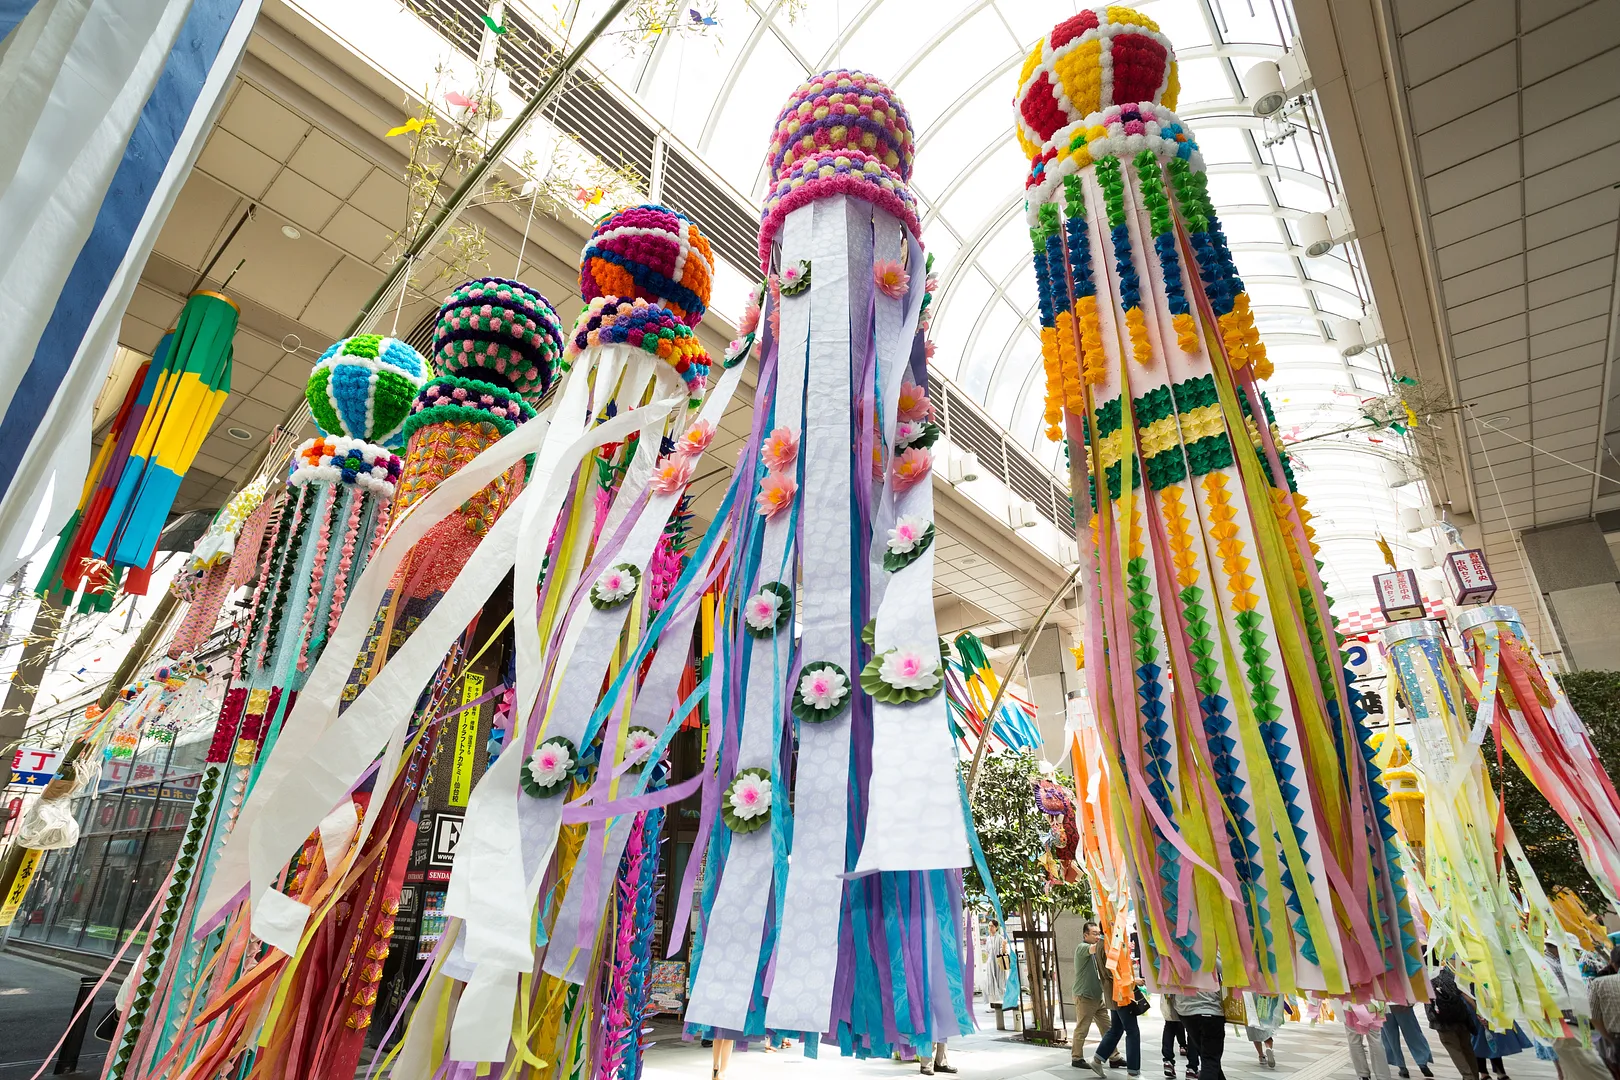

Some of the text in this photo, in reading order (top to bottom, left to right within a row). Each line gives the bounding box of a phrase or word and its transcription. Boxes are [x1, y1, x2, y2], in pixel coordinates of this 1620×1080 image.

[452, 686, 473, 802] ESPタークラフトアカデミー仙台校
[429, 871, 452, 879] SENDA
